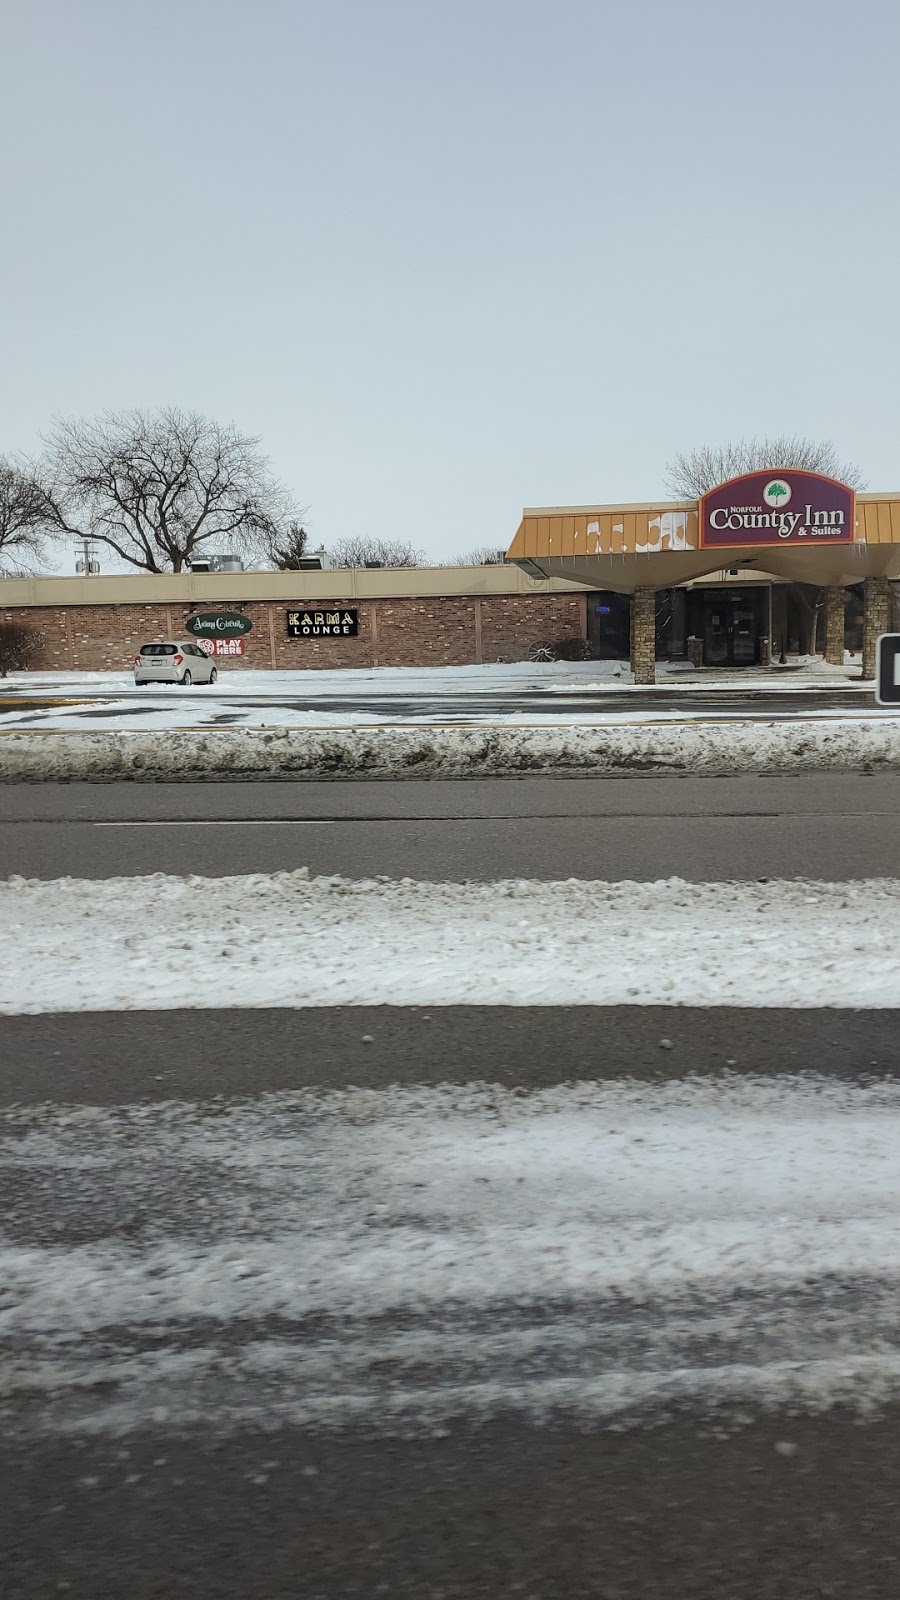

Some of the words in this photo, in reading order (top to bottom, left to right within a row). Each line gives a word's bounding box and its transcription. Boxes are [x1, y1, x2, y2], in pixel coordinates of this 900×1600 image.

[709, 508, 803, 538] Country
[804, 504, 845, 526] Inn
[798, 527, 808, 536] &
[811, 525, 842, 536] Suites
[288, 612, 354, 625] KARMA
[294, 626, 350, 634] LOUNGE
